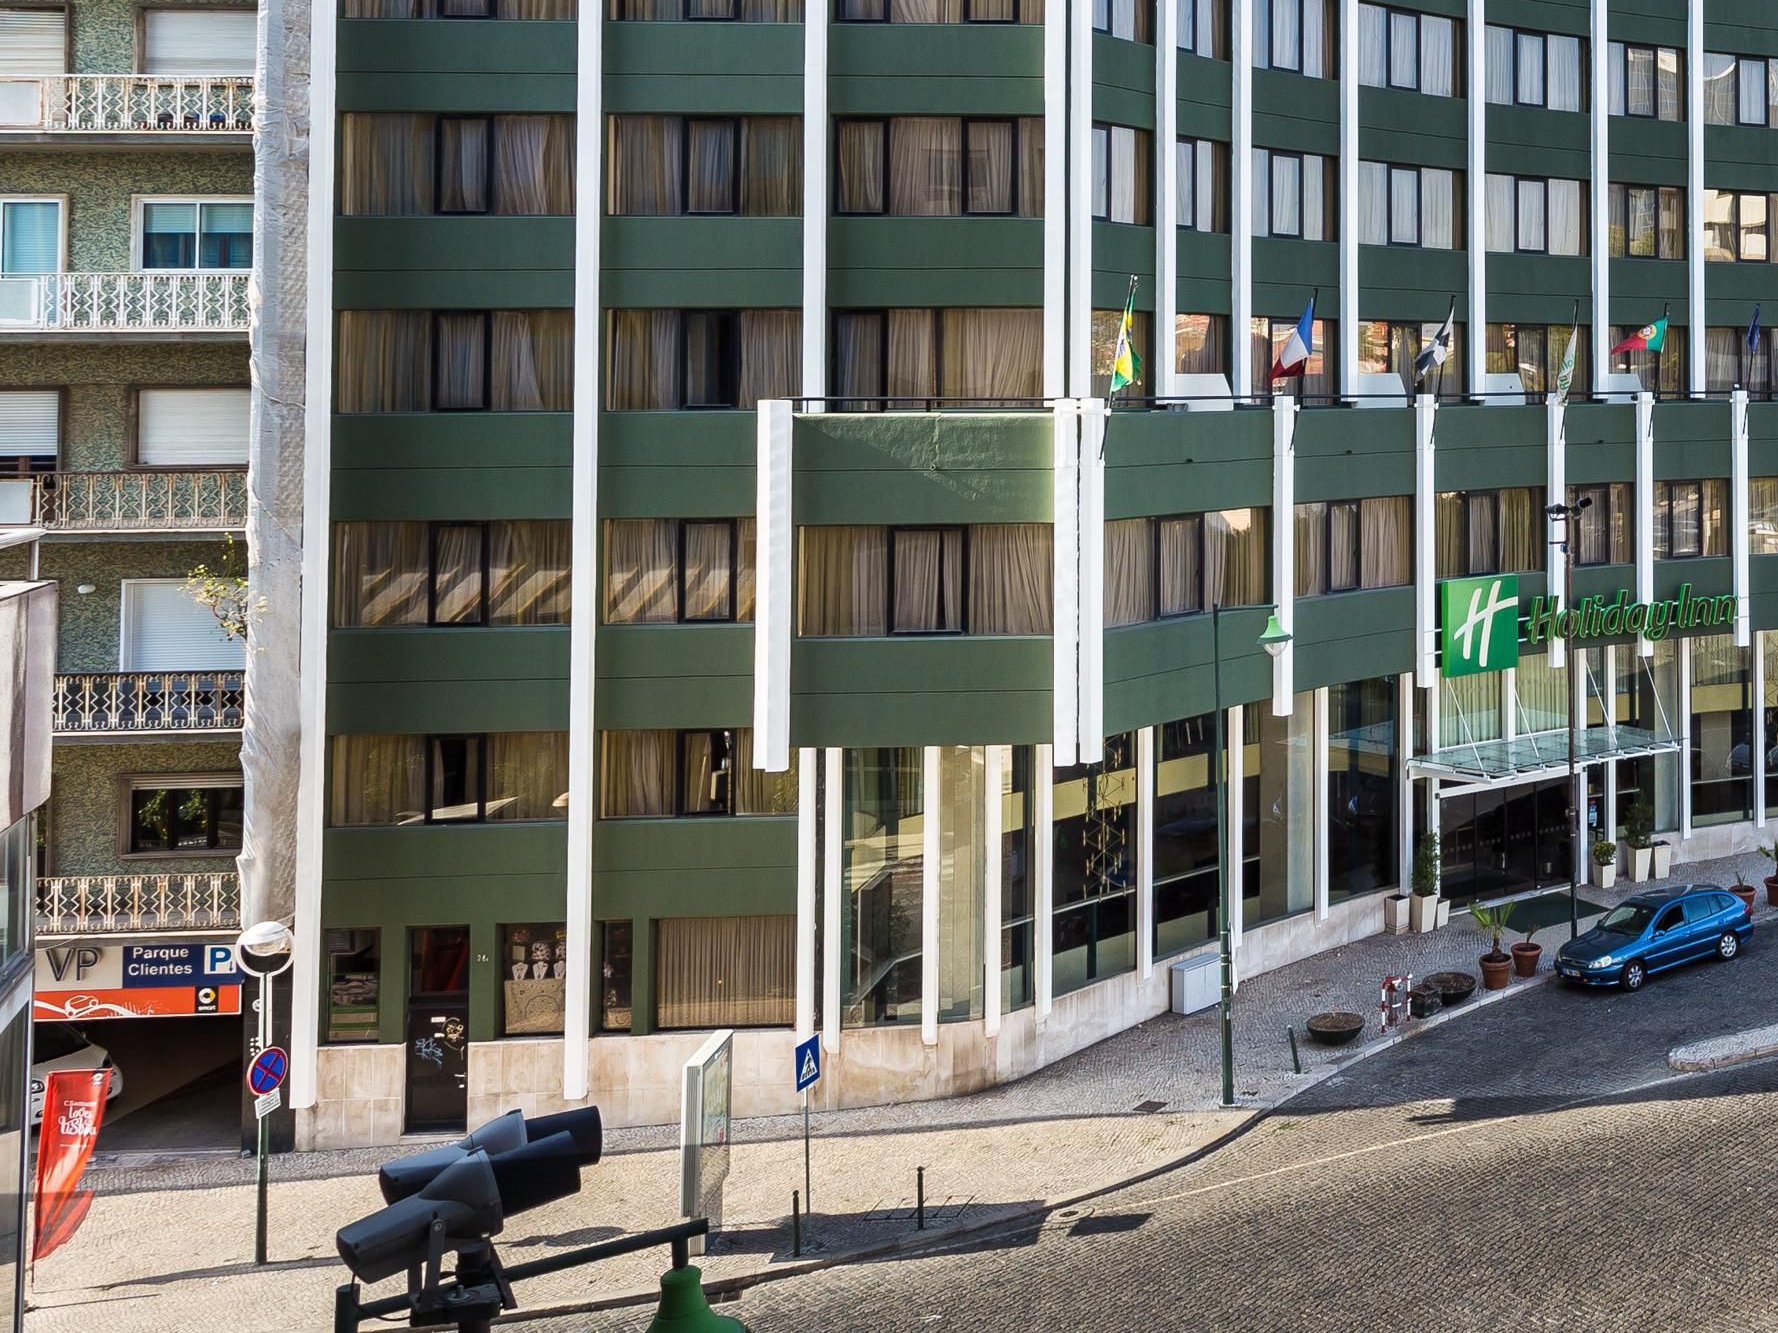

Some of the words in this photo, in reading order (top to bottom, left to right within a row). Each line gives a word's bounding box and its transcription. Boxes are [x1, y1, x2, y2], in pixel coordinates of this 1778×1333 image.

[1525, 588, 1673, 645] Holiday
[1677, 582, 1738, 630] Inn
[46, 946, 102, 982] VP
[132, 946, 189, 961] Parque
[209, 947, 232, 972] P
[128, 962, 193, 976] Clientes
